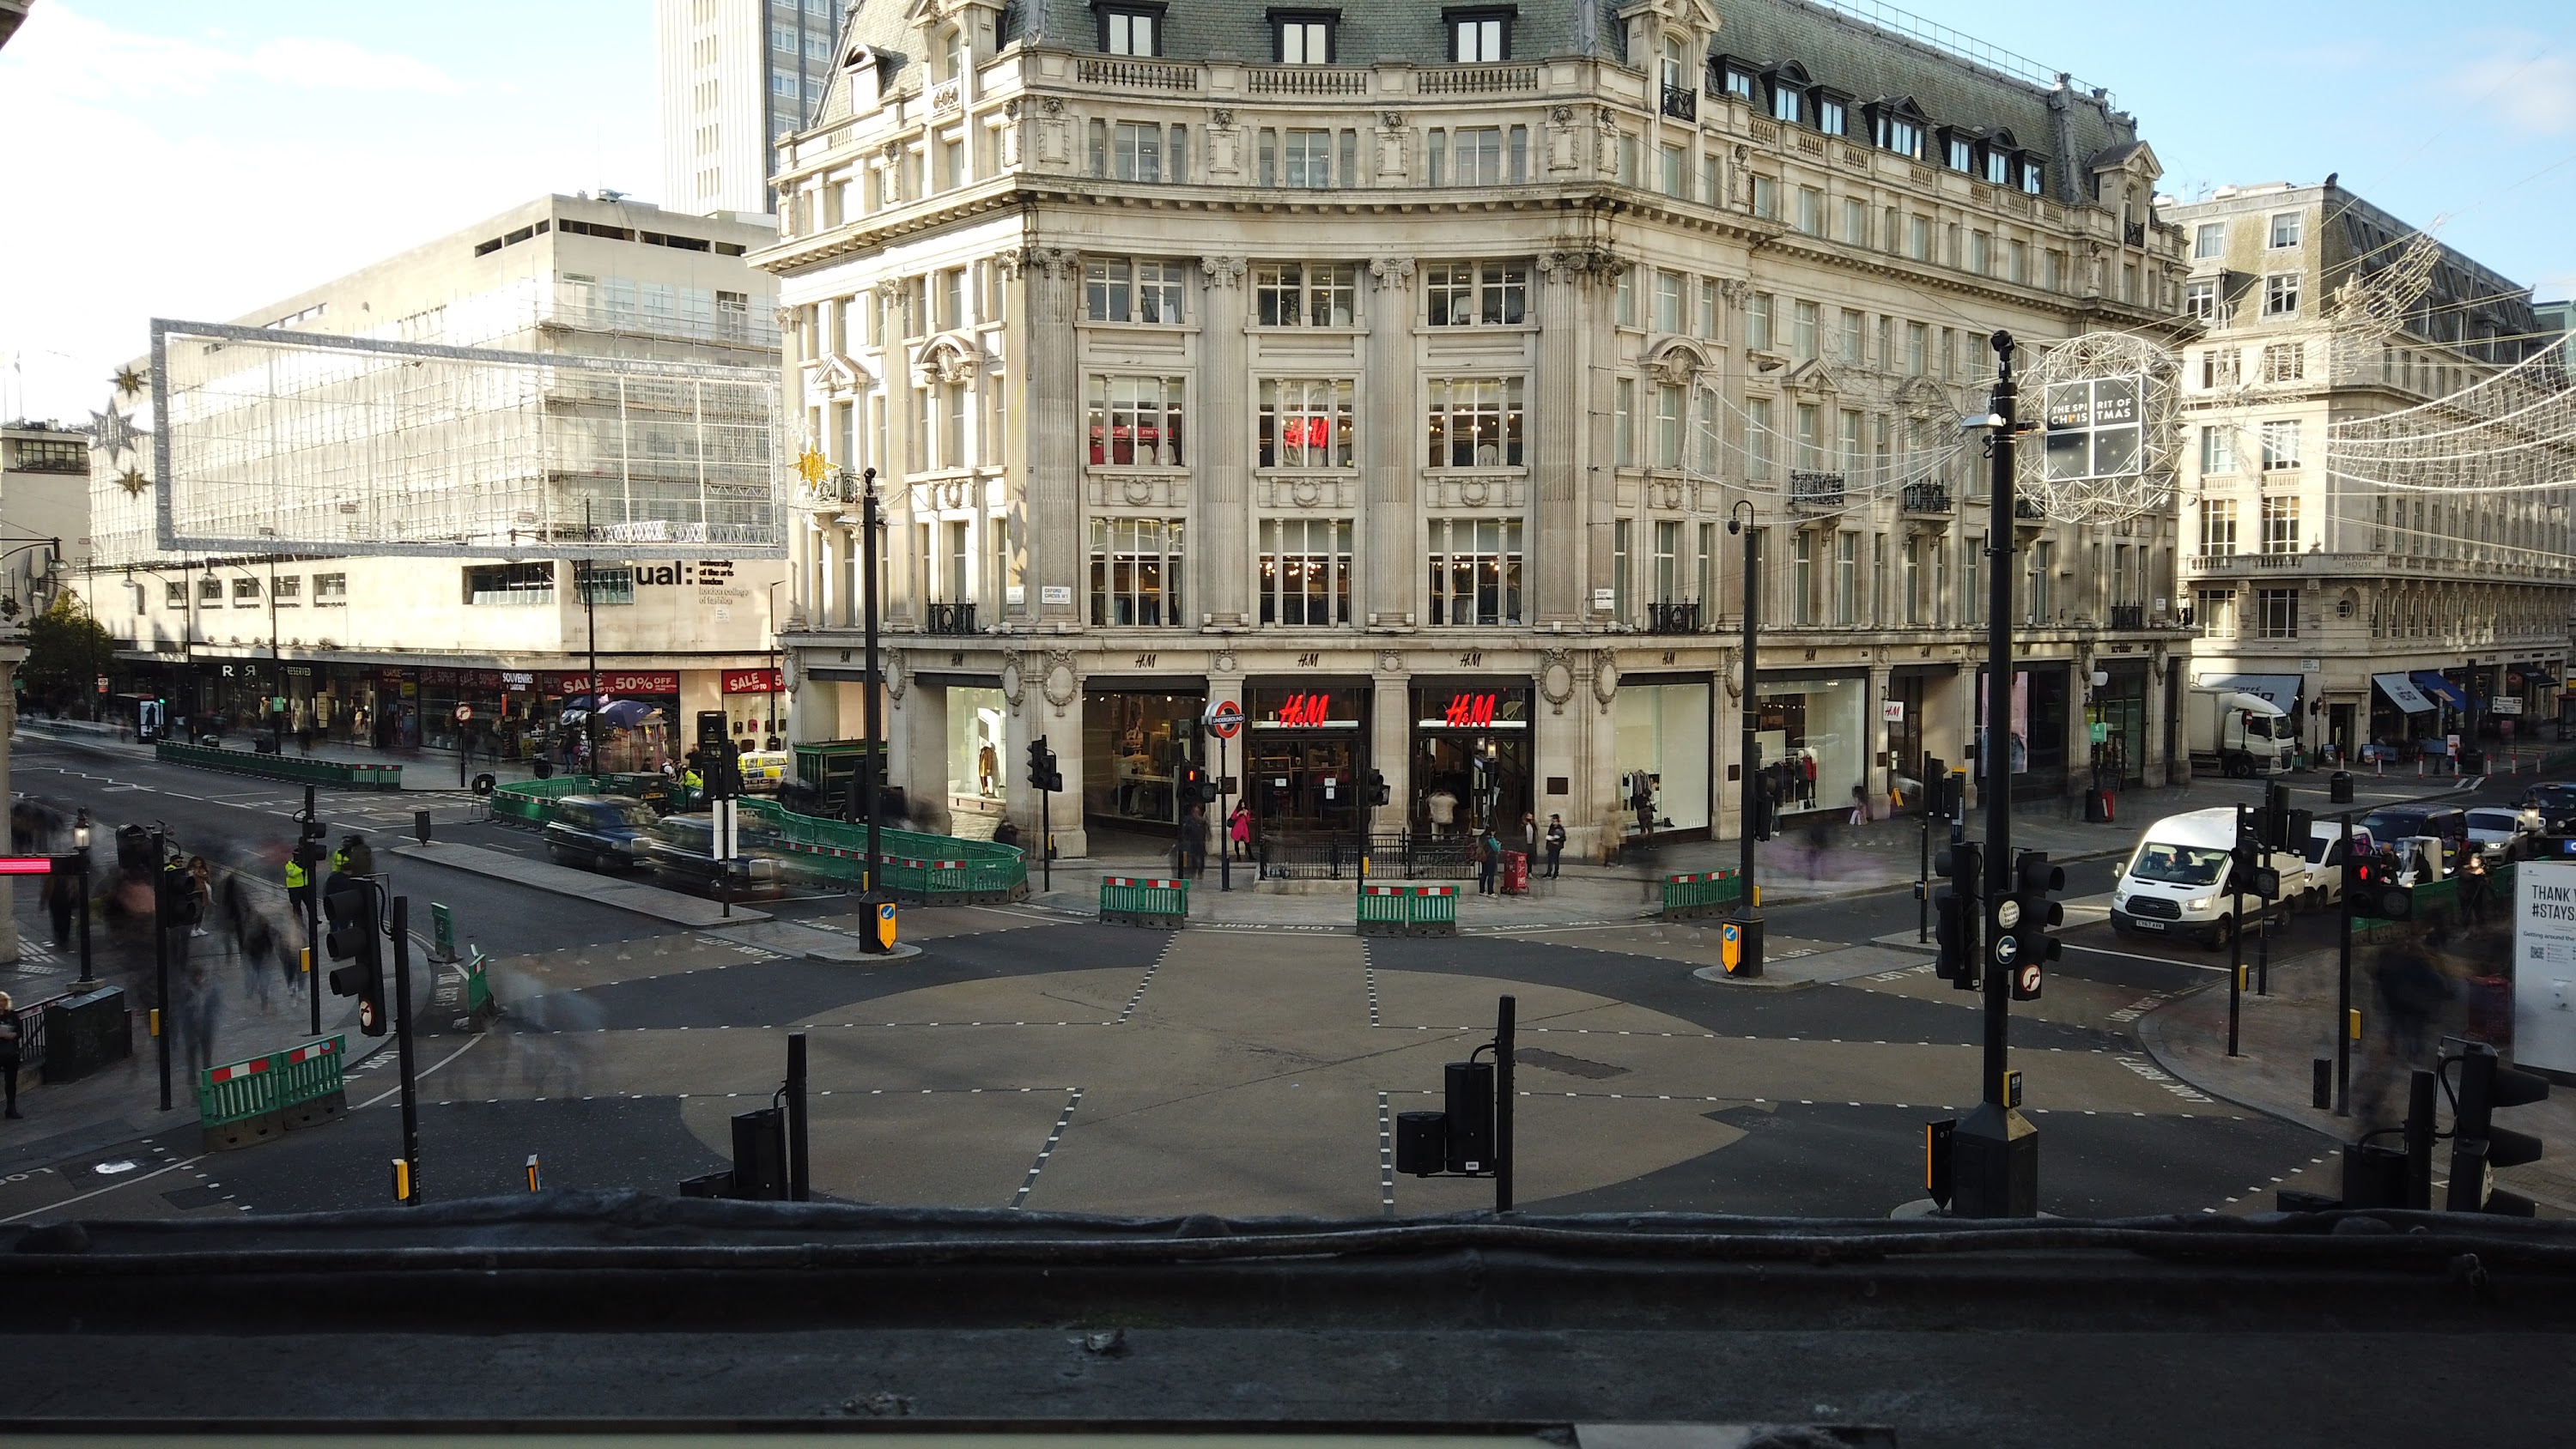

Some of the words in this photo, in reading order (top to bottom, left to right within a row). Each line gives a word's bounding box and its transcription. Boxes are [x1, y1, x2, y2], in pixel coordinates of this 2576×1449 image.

[2052, 404, 2070, 414] THE
[2117, 397, 2131, 408] OF
[951, 652, 963, 667] H&M
[1662, 652, 1675, 665] H&M
[1805, 648, 1817, 662] H&M
[1921, 646, 1931, 658] H&M
[1135, 653, 1157, 669] H&M
[1297, 652, 1320, 668] H&M
[1460, 652, 1482, 668] H&M
[222, 665, 234, 676] R
[287, 666, 312, 676] RESERVED
[502, 671, 533, 684] SOUVENIRS
[563, 676, 605, 694] SALE
[615, 676, 653, 690] 50%
[730, 672, 761, 692] SALE
[775, 674, 785, 687] 5
[1279, 694, 1330, 729] H&M
[1446, 694, 1497, 729] H&M
[1885, 706, 1901, 718] H&M
[1212, 715, 1243, 724] UNDERGROUND
[613, 774, 635, 783] CONWAY
[2532, 884, 2571, 902] THANK
[2532, 902, 2576, 921] #STAYS
[2523, 931, 2543, 940] Getting
